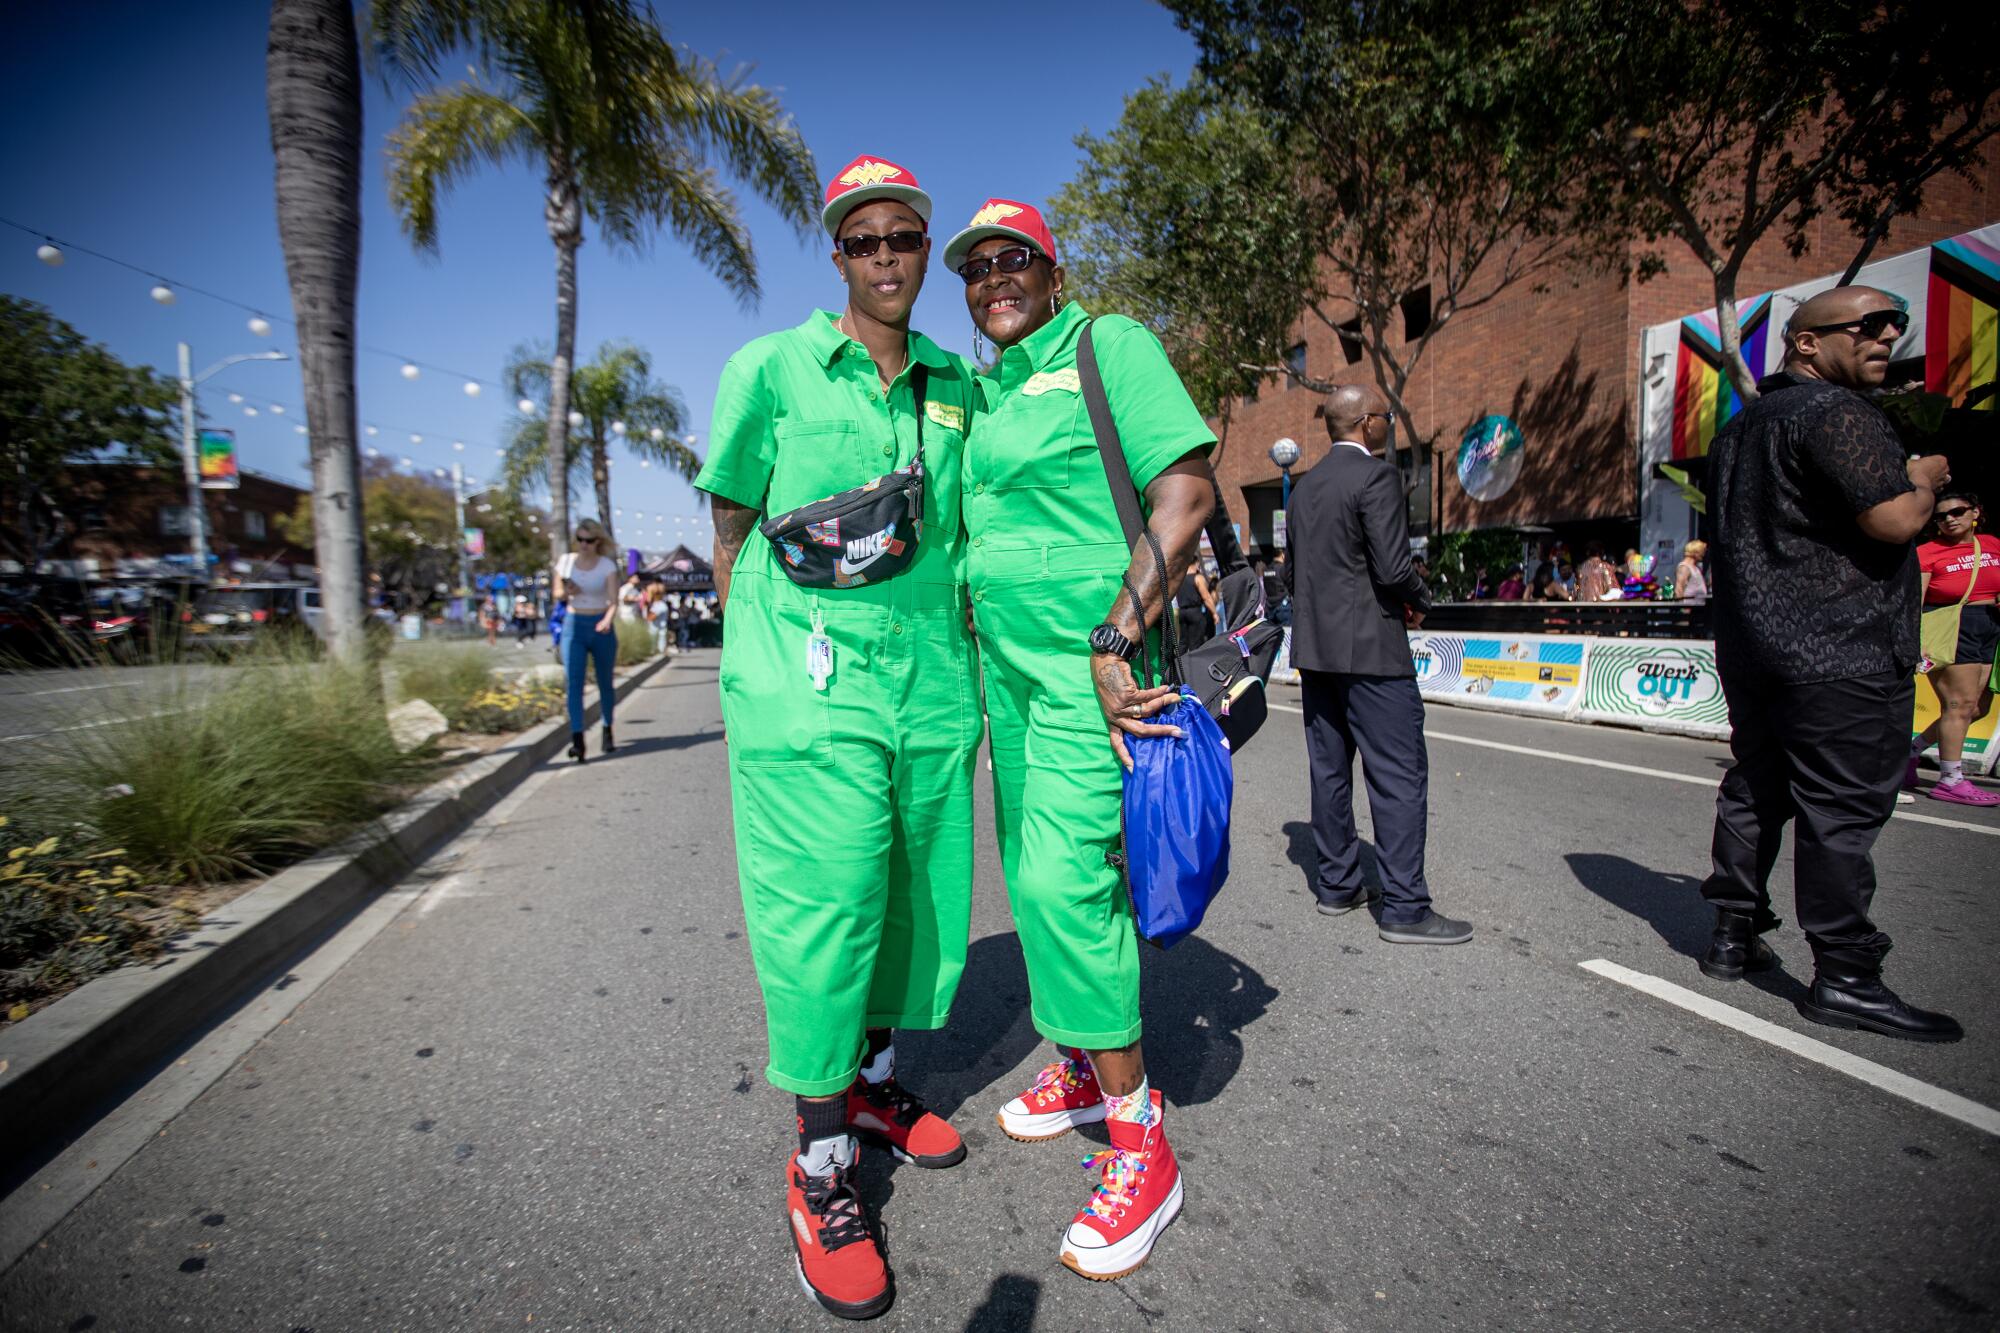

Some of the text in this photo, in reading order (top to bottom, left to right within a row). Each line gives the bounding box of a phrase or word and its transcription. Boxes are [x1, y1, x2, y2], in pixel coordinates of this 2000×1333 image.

[846, 529, 891, 560] NIKE
[1946, 564, 1960, 572] BUT
[1961, 560, 1990, 569] WITOUT
[1637, 662, 1700, 681] Werk
[1637, 676, 1696, 700] OUT
